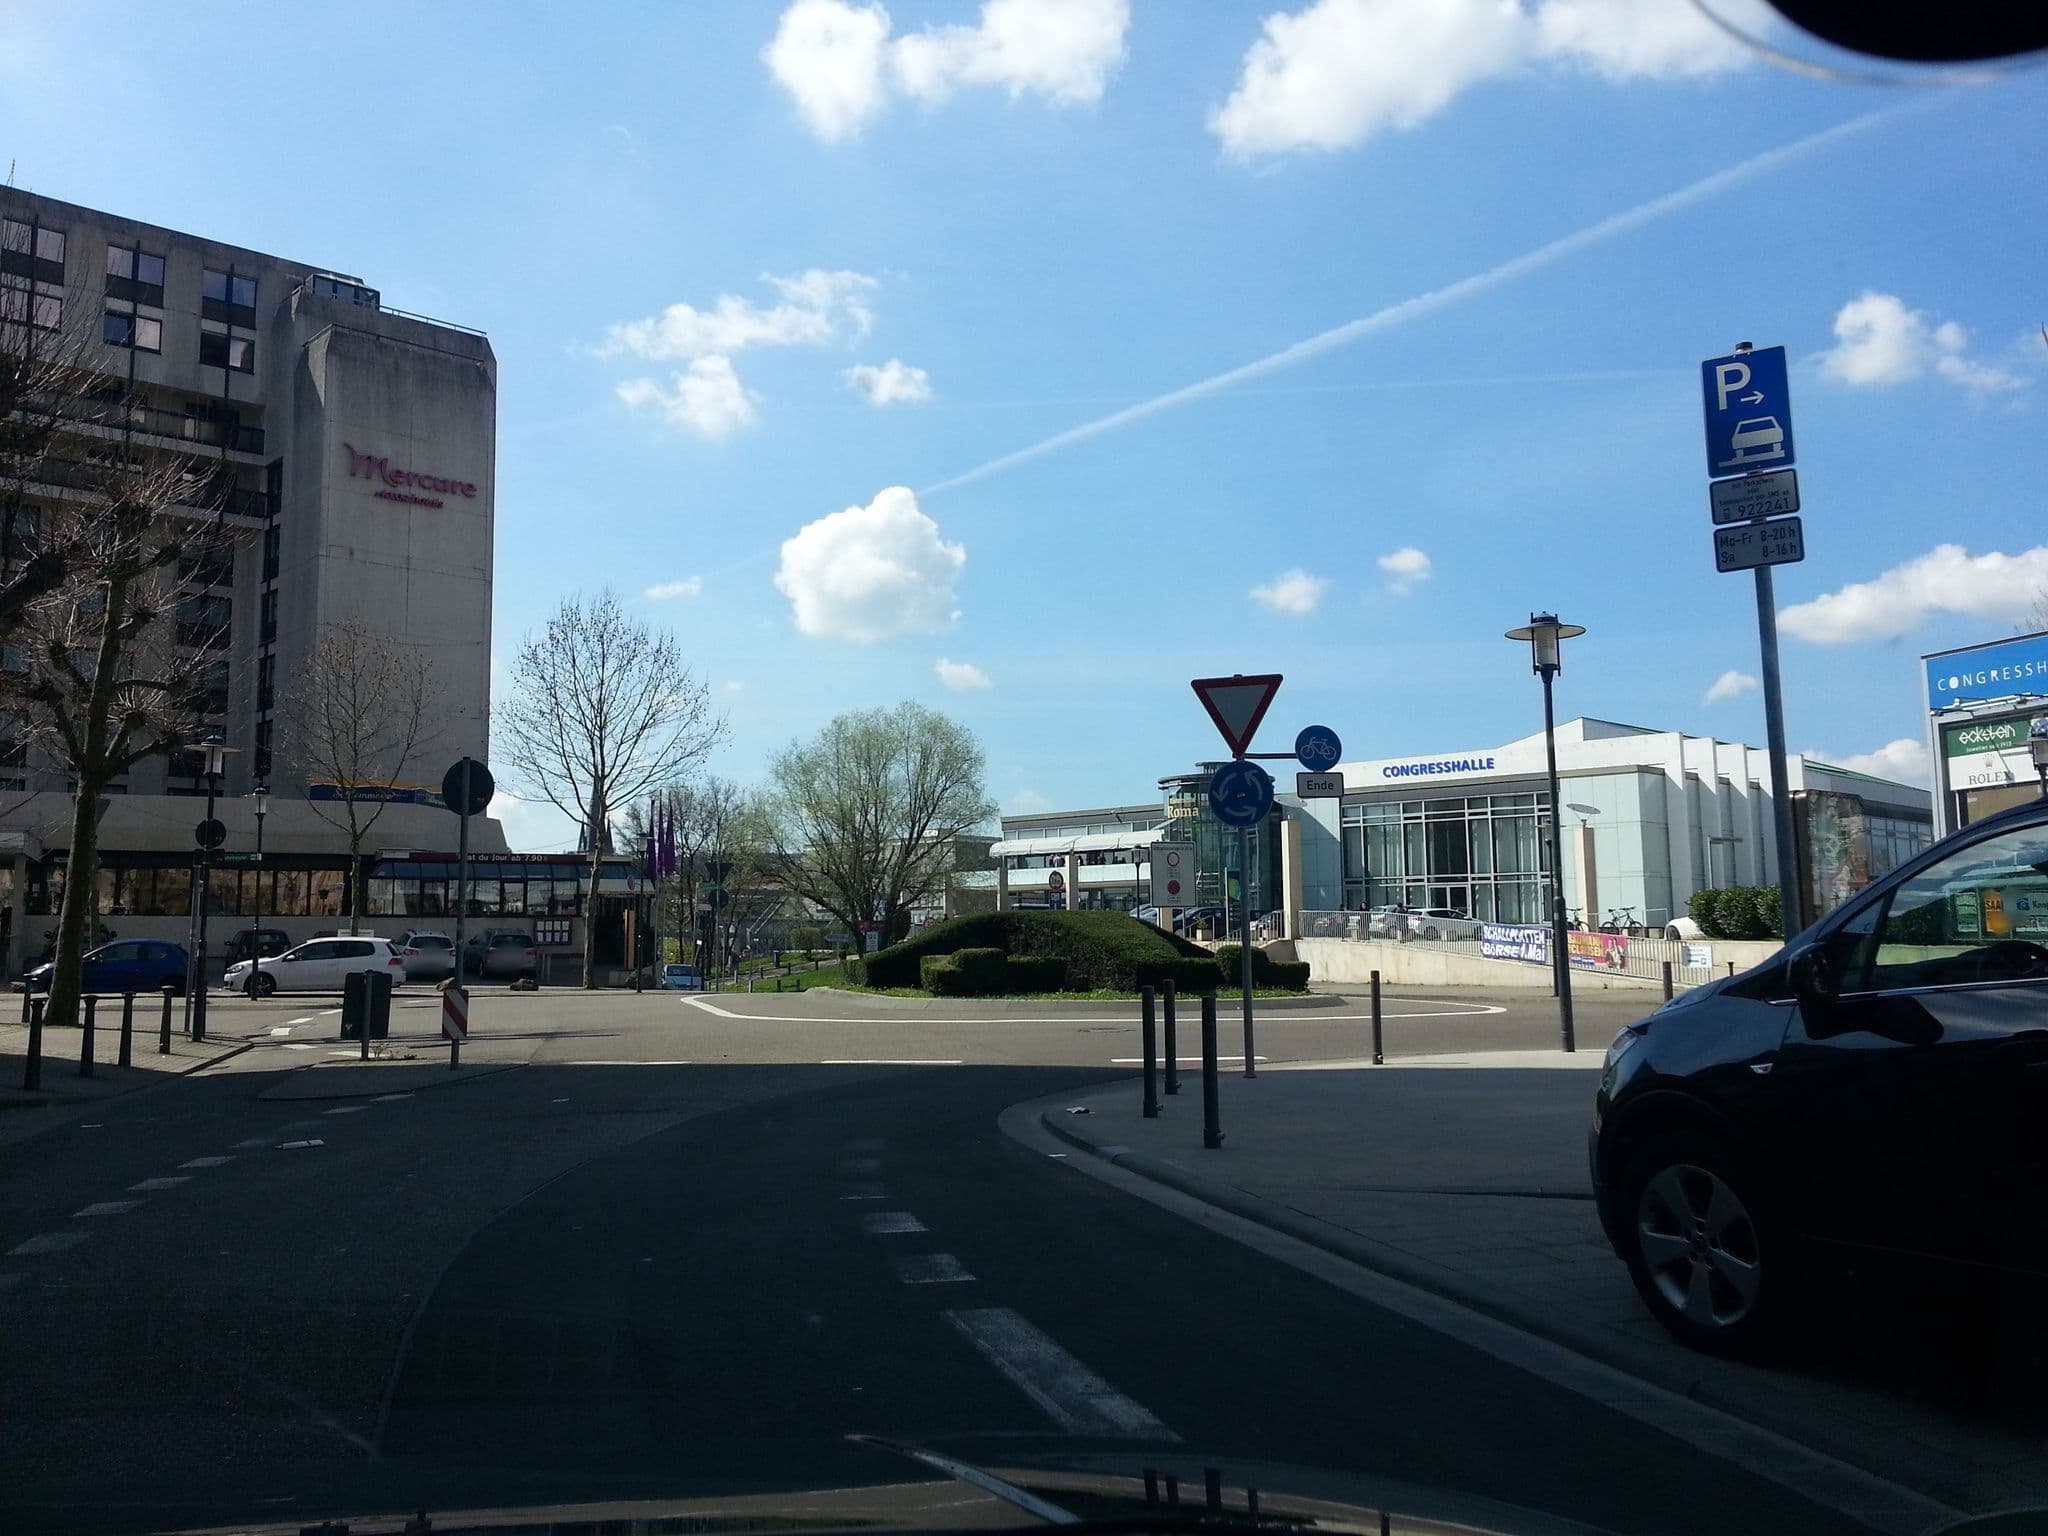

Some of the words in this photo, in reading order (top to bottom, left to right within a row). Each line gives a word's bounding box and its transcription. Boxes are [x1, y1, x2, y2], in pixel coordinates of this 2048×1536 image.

[1715, 361, 1752, 410] P
[343, 443, 478, 498] Mercure
[1738, 497, 1789, 517] 922241
[1720, 551, 1736, 564] Sa
[1762, 543, 1787, 558] 8-16
[1790, 541, 1797, 554] h
[1937, 660, 2048, 692] CONGRESSH
[1958, 722, 2017, 745] eckstein
[1382, 757, 1495, 778] CONGRESSHALLE
[1306, 779, 1334, 790] Ende
[1167, 805, 1200, 819] Roma
[1483, 926, 1545, 944] SCHALLPLATTEN
